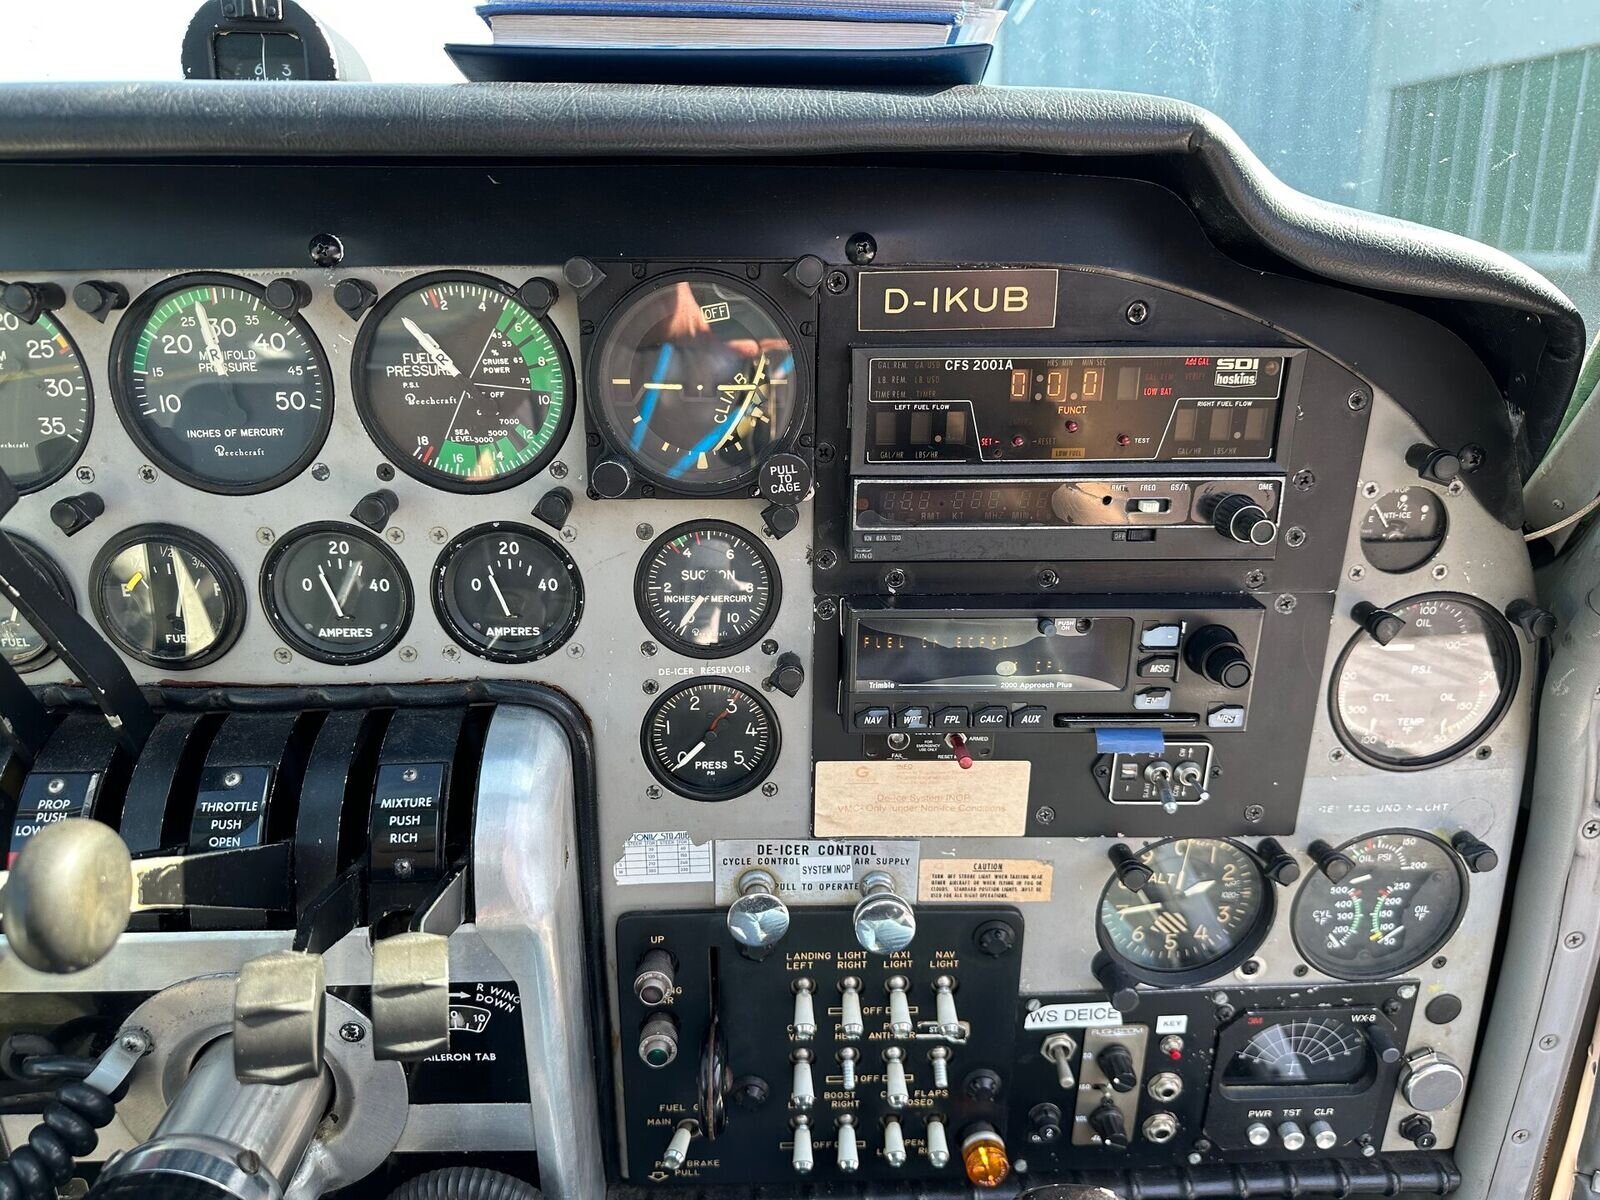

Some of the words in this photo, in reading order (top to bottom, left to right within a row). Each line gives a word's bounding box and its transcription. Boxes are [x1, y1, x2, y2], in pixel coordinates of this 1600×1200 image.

[884, 286, 1028, 314] D-IKUB
[704, 305, 726, 320] OFF
[244, 315, 259, 325] 35
[163, 335, 192, 353] 20
[254, 333, 285, 351] 40
[27, 340, 54, 358] 25
[945, 360, 969, 371] CFS
[973, 360, 1013, 370] 2001A
[1216, 358, 1259, 369] SDI
[1216, 373, 1255, 384] hoskins
[44, 379, 73, 396] 30
[1160, 387, 1172, 395] BAT
[159, 394, 181, 413] 10
[276, 392, 305, 410] 50
[405, 393, 457, 405] Beechcraft
[1058, 406, 1087, 414] FUNCT
[38, 417, 65, 434] 35
[187, 429, 221, 438] INCHES
[225, 429, 236, 437] OF
[241, 428, 284, 437] MERCURY
[215, 445, 265, 457] Beechcraft
[770, 465, 797, 475] PULL
[778, 475, 792, 483] TO
[770, 482, 800, 494] CAGE
[328, 541, 349, 555] 20
[499, 541, 520, 555] 20
[369, 579, 390, 592] 40
[538, 579, 558, 592] 40
[664, 582, 672, 593] 2
[727, 613, 739, 623] 10
[1416, 619, 1432, 627] OIL
[318, 627, 373, 638] AMPERES
[486, 626, 540, 637] AMPERES
[1, 638, 30, 647] FUEL
[700, 666, 751, 674] RESERVOIR
[1150, 665, 1170, 673] MSG
[1019, 682, 1054, 691] Approach
[1440, 693, 1455, 701] OIL
[690, 696, 700, 710] 2
[726, 700, 737, 713] 3
[980, 715, 1003, 723] CALC
[1022, 715, 1041, 723] AUX
[745, 723, 758, 736] 4
[734, 750, 745, 765] 5
[695, 761, 728, 769] PRESS
[38, 799, 71, 810] PROP
[201, 801, 258, 812] THROTTLE
[381, 797, 432, 808] MIXTURE
[35, 812, 67, 823] PUSH
[389, 815, 421, 826] PUSH
[211, 820, 242, 830] PUSH
[209, 837, 240, 847] OPEN
[390, 833, 418, 843] RICH
[757, 845, 809, 855] DE-ICER
[818, 845, 876, 855] CONTROL
[1359, 855, 1374, 863] OIL
[802, 865, 831, 874] SYSTEM
[834, 865, 851, 873] INOP
[1150, 873, 1175, 884] ALT
[1394, 882, 1410, 890] 250
[1313, 910, 1332, 918] CYL
[651, 936, 664, 944] UP
[786, 952, 831, 960] LANDING
[935, 951, 956, 959] NAV
[787, 962, 814, 970] LEFT
[837, 961, 867, 969] RIGHT
[883, 960, 913, 968] LIGHT
[930, 960, 959, 968] LIGHT
[490, 986, 520, 1003] WING
[476, 994, 515, 1013] DOWN
[1030, 1010, 1058, 1022] WS
[1065, 1008, 1118, 1021] DEICE
[1351, 1014, 1376, 1022] WX-8
[1248, 1017, 1263, 1025] 3M
[1248, 1110, 1272, 1118] PWR
[1283, 1108, 1302, 1116] TST
[1314, 1108, 1334, 1116] CLR
[813, 1141, 832, 1149] OFF
